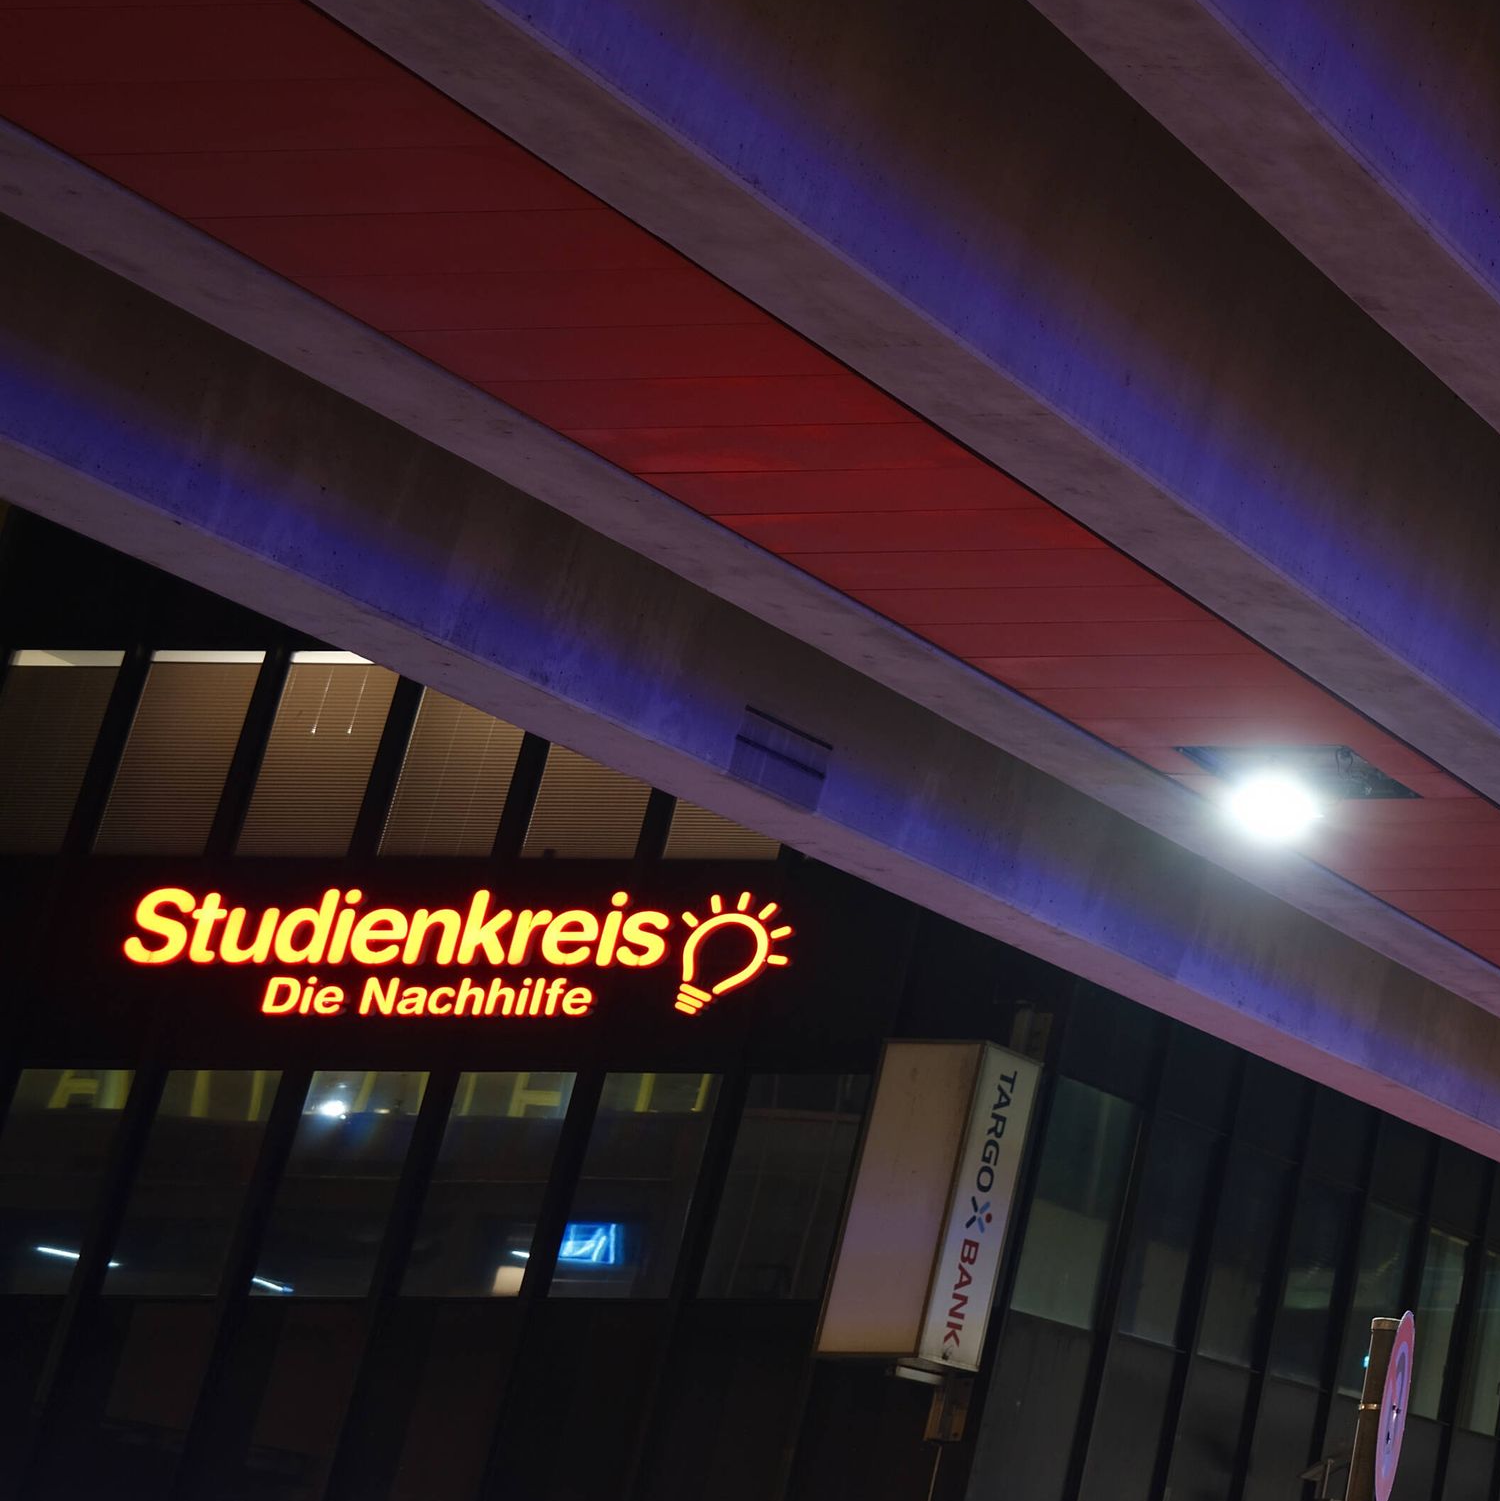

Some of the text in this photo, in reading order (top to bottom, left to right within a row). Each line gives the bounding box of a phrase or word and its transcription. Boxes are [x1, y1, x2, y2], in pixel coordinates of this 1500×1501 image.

[123, 886, 670, 968] Studienkreis
[260, 975, 595, 1017] Die Nachhilfe
